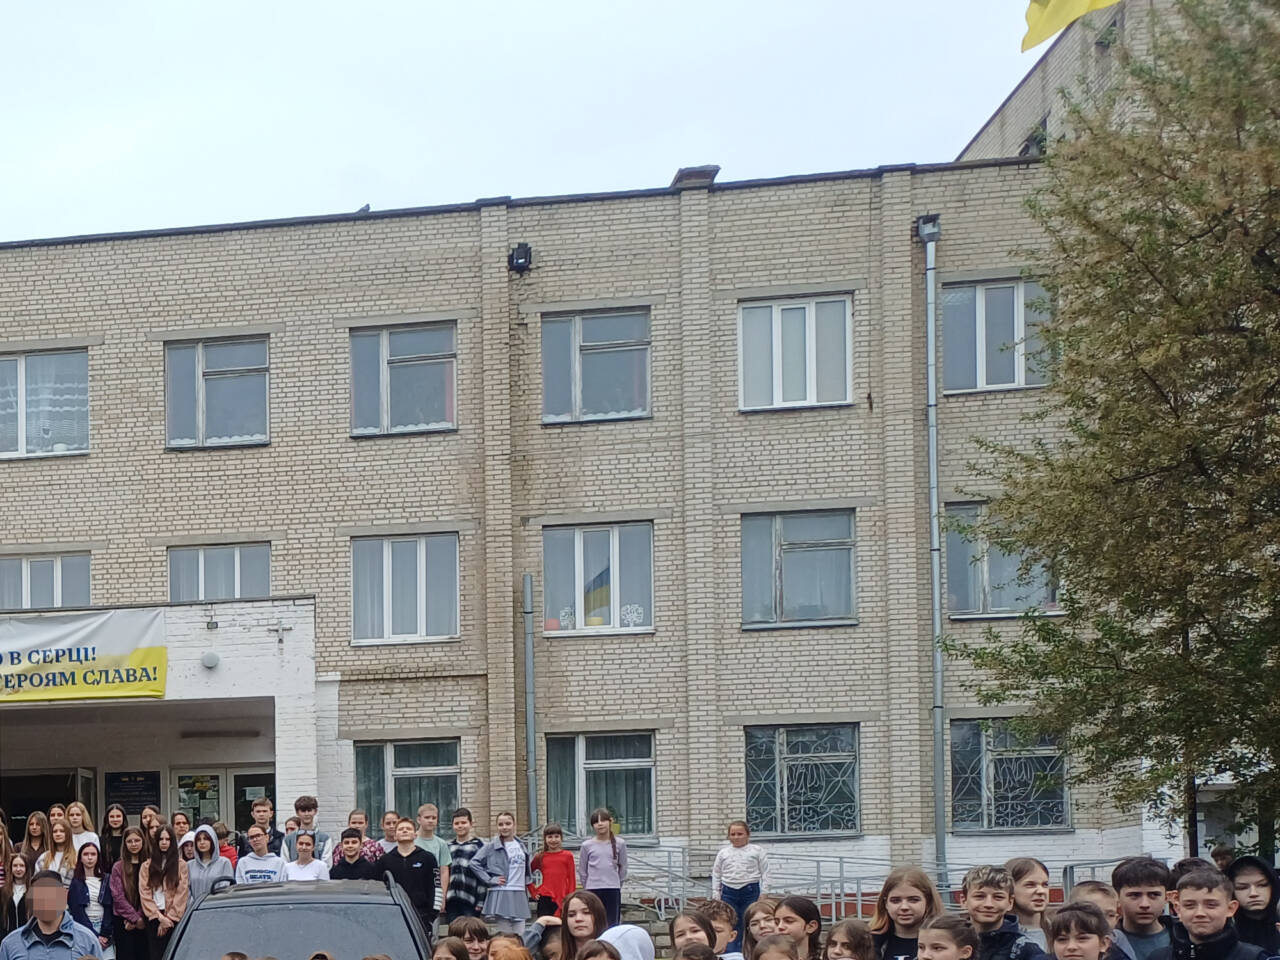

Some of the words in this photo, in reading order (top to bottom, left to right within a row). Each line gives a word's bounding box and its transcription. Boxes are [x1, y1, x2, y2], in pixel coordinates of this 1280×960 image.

[10, 651, 22, 666] В
[27, 647, 97, 665] СЕРЦІ!
[82, 667, 158, 686] СЛАВА!
